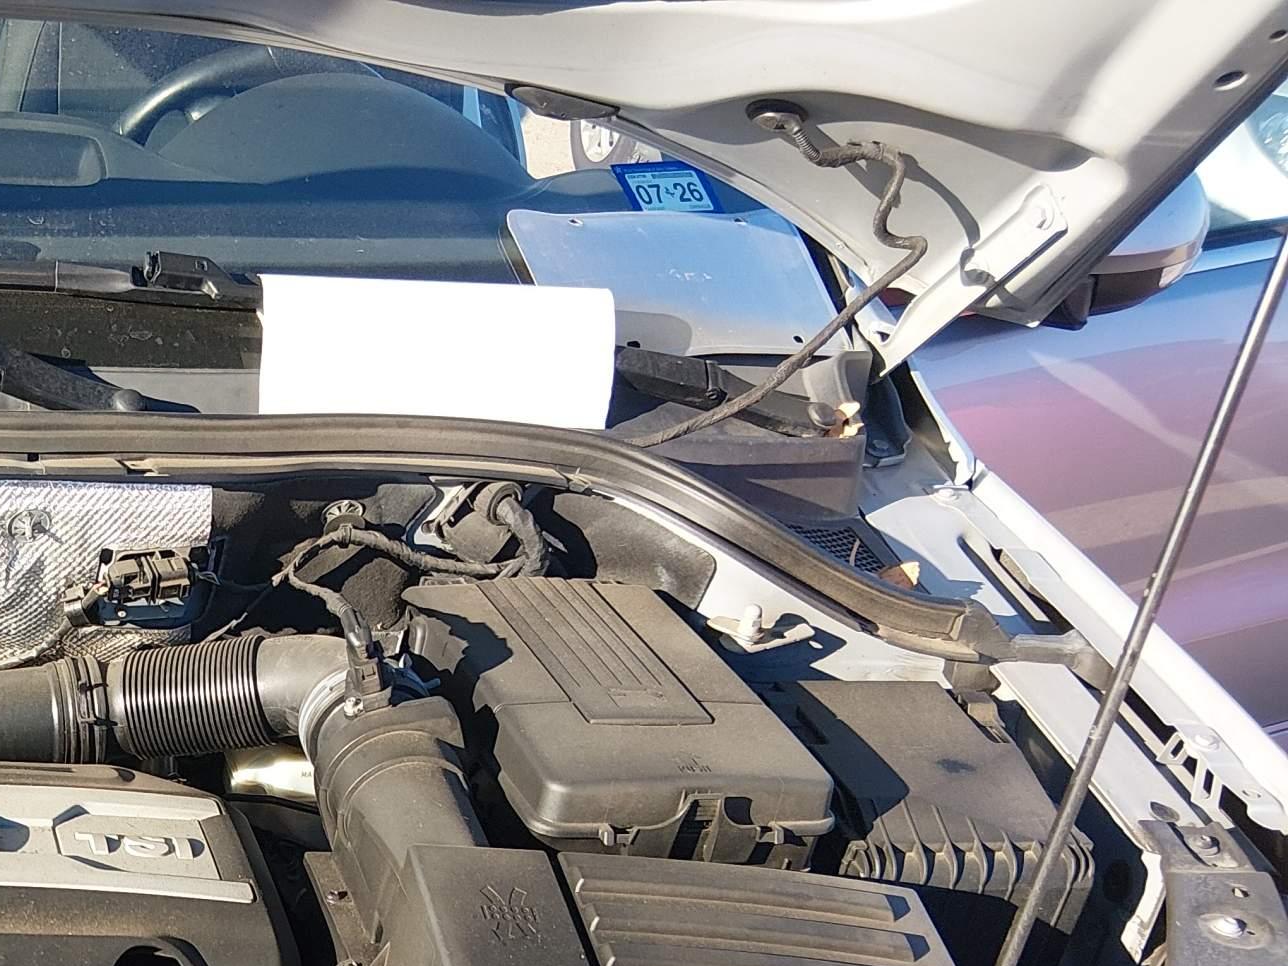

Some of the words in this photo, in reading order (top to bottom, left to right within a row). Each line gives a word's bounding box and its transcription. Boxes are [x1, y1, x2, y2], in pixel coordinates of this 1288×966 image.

[635, 184, 663, 205] 07
[673, 182, 704, 203] 26
[74, 832, 197, 860] TSI
